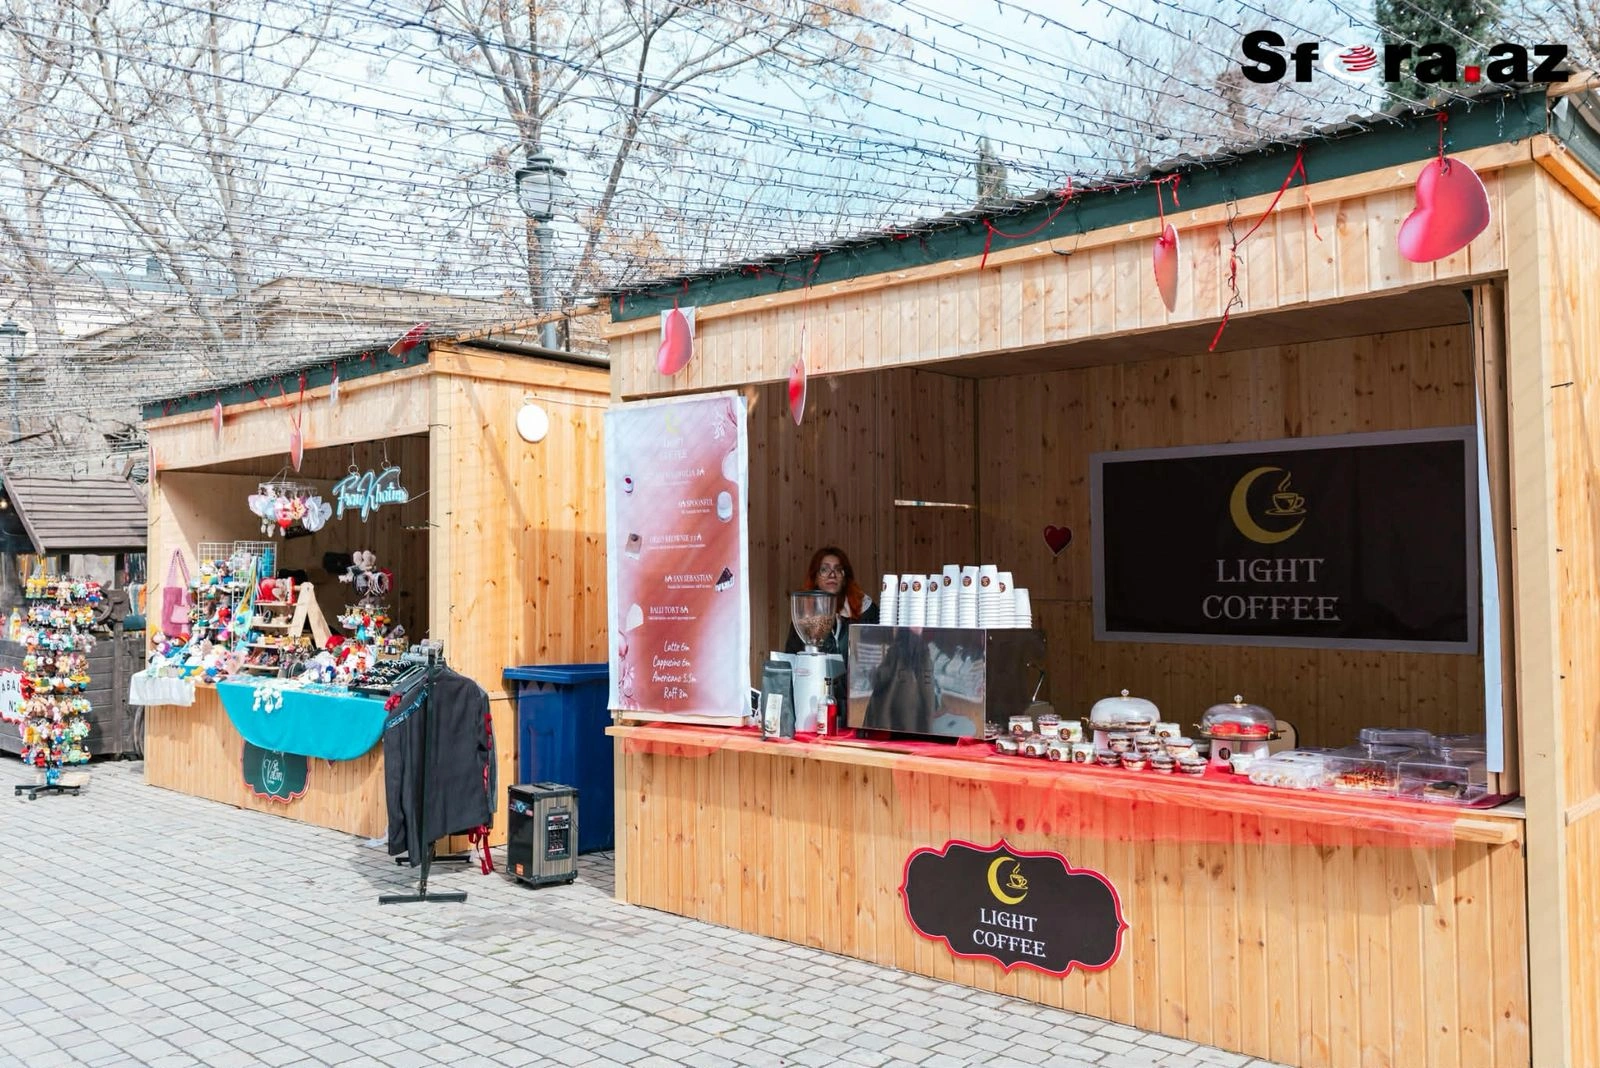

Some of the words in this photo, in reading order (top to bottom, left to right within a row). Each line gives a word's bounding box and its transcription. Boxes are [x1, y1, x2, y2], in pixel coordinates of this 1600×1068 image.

[1216, 558, 1324, 583] LIGHT
[1202, 595, 1341, 621] COFFEE
[663, 640, 680, 652] Latte
[980, 908, 1038, 933] LIGHT
[973, 928, 1046, 958] COFFEE
